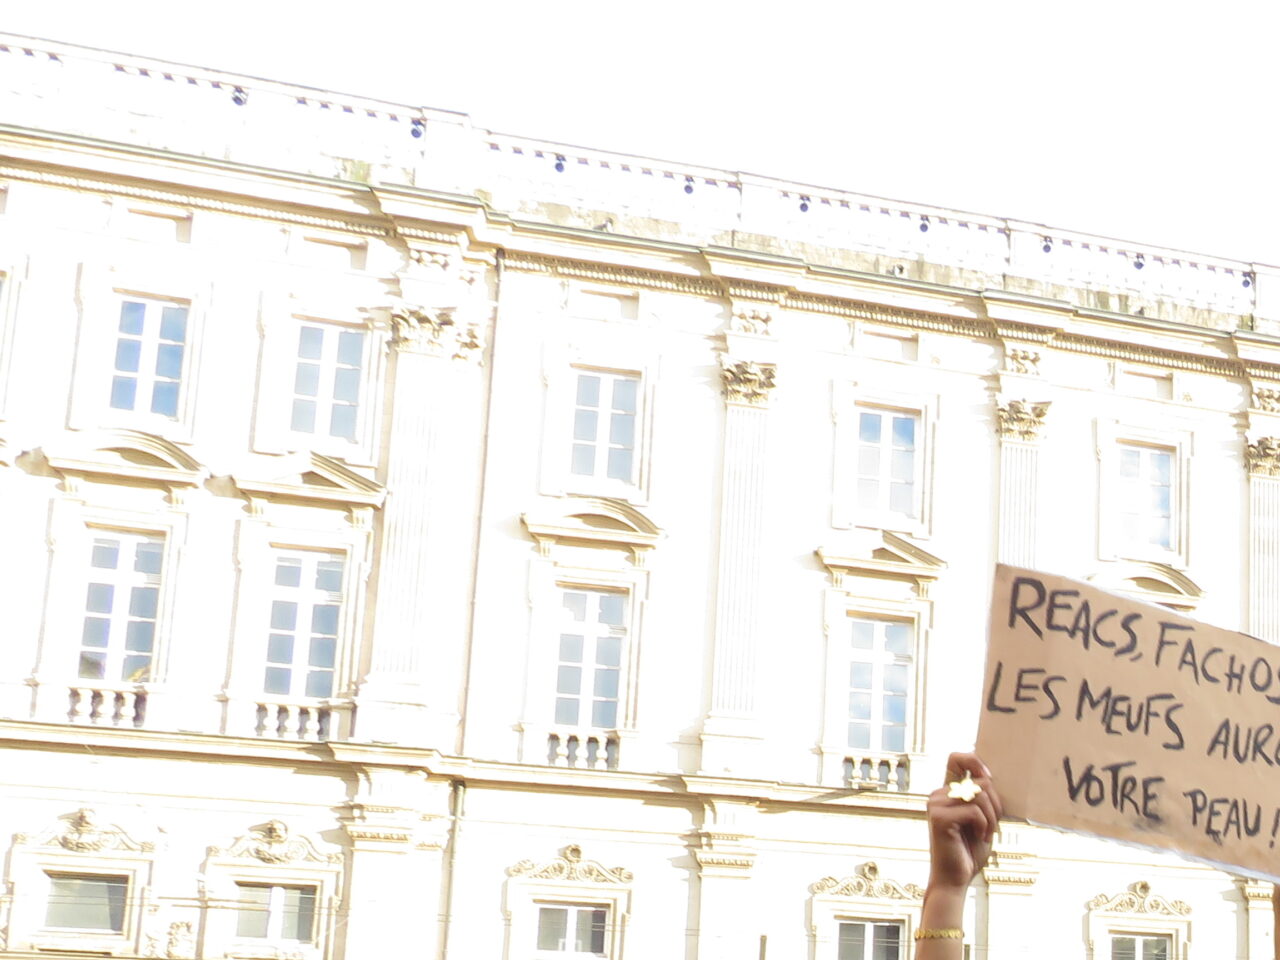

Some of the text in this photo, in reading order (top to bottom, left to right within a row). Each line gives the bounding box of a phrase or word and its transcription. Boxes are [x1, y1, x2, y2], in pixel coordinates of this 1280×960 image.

[1007, 577, 1142, 662] REACS,
[986, 661, 1067, 720] LES
[1074, 678, 1185, 751] MEUFS
[1062, 756, 1165, 823] VOTRE
